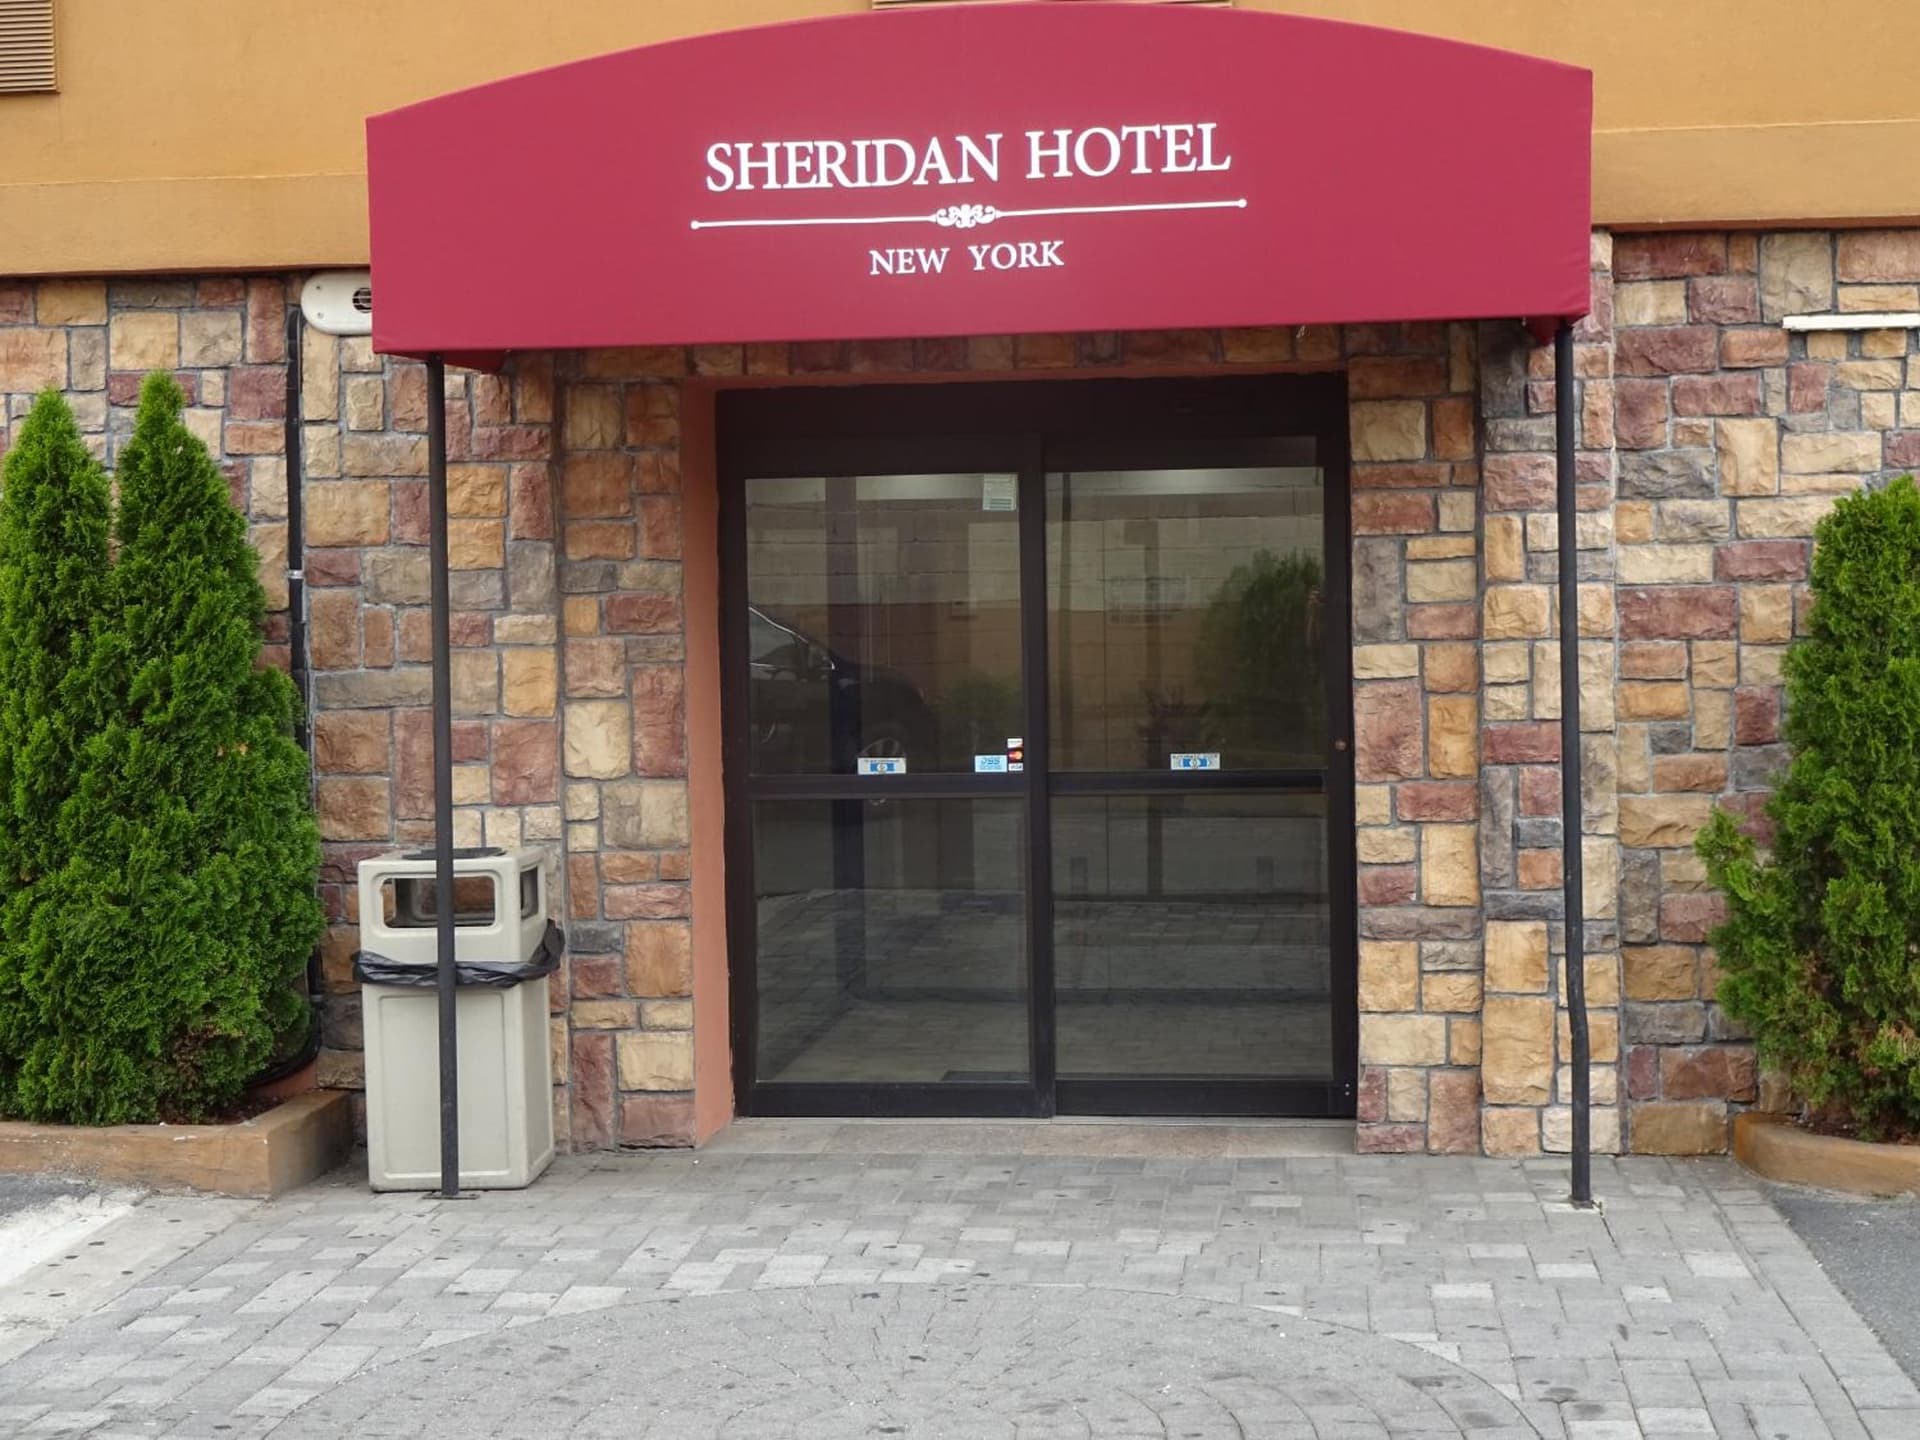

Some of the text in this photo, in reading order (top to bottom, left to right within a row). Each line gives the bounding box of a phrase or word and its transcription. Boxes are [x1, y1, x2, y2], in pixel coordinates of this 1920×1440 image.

[706, 122, 1232, 192] SHERIDAN HOTEL
[868, 240, 1065, 276] NEW YORK
